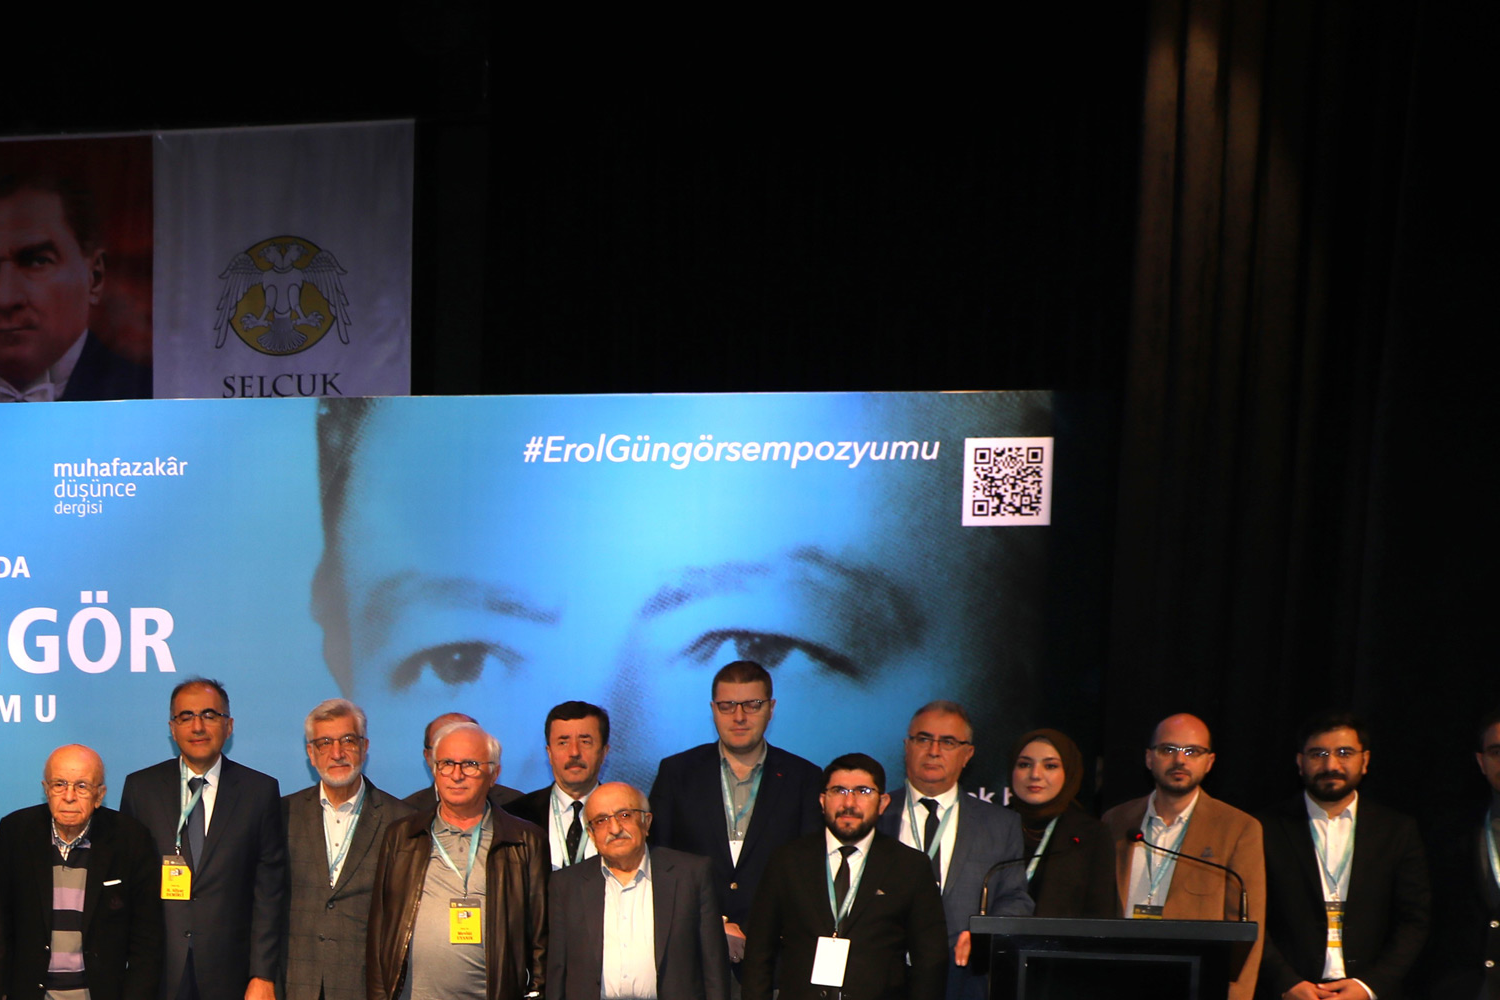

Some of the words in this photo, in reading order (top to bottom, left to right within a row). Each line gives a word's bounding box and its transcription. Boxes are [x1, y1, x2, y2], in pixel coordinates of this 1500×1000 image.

[523, 433, 941, 470] #ErolGüngörsempozyumu
[53, 456, 189, 478] muhafazakâr
[53, 478, 137, 502] düşünce
[53, 500, 103, 518] dergisi
